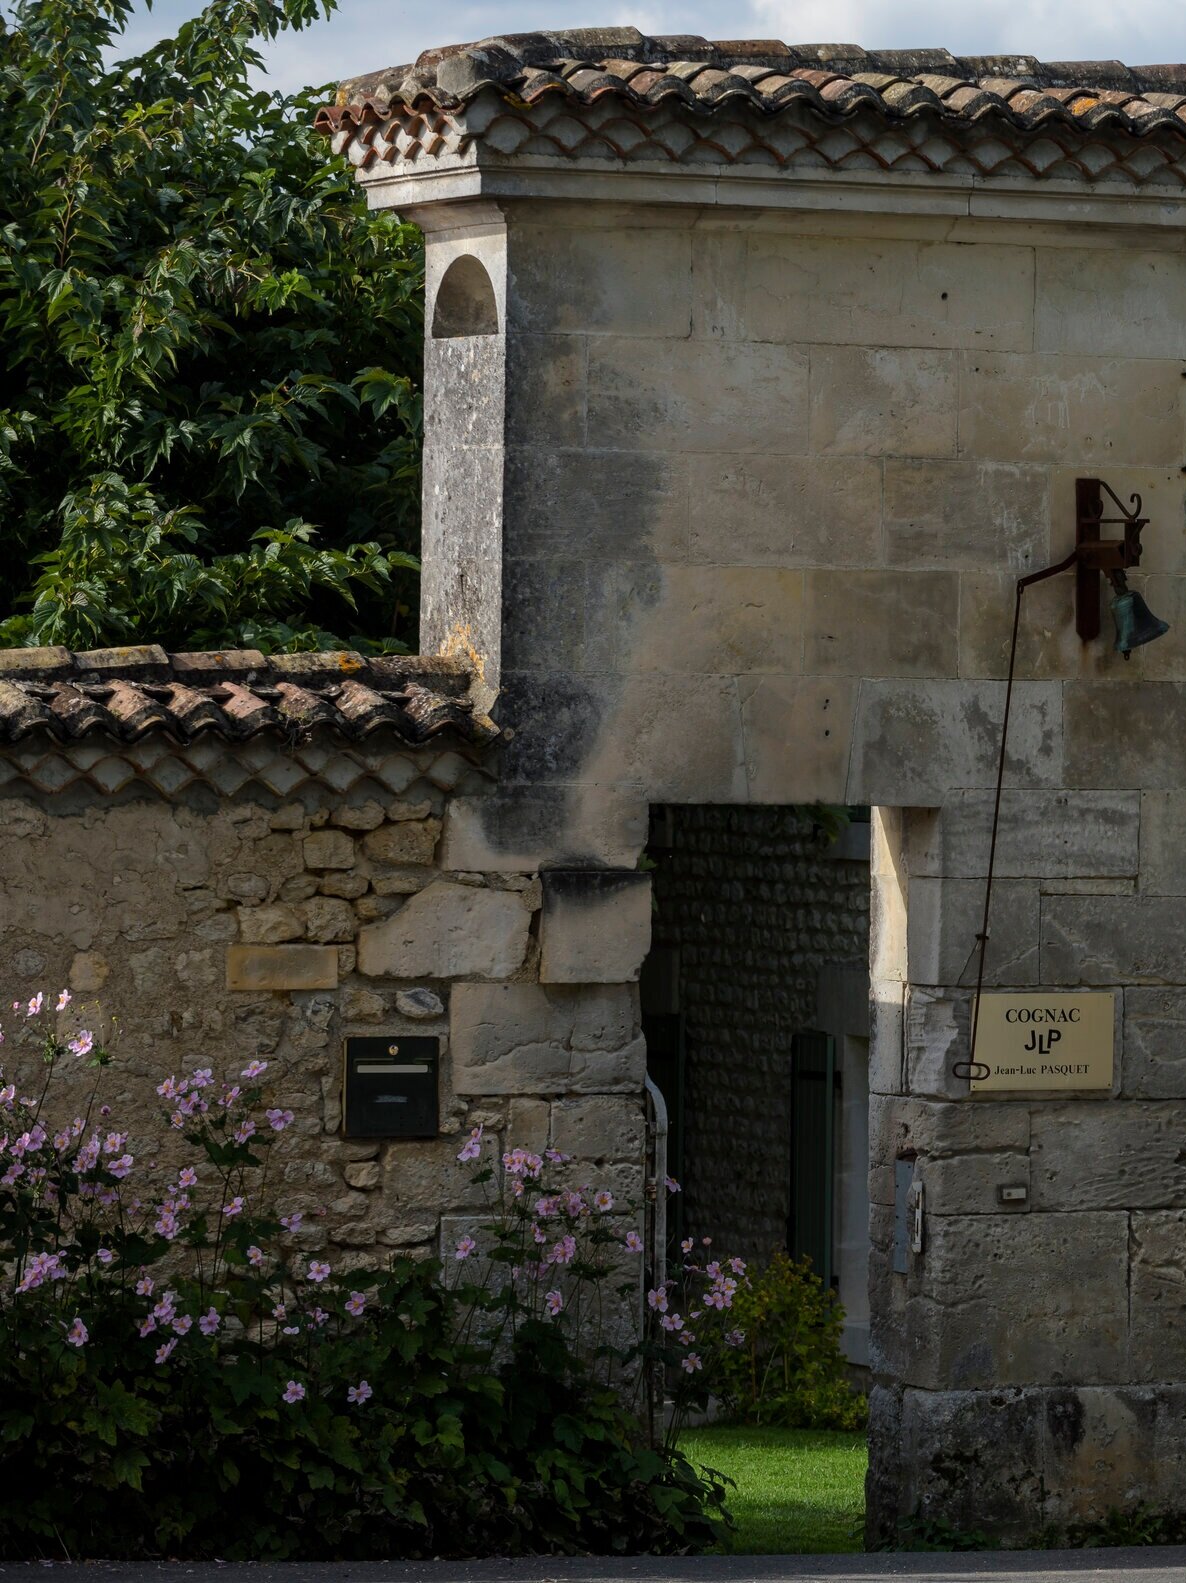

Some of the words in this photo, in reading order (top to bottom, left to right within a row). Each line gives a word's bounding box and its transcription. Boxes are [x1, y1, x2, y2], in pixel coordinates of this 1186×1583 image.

[1005, 1008, 1081, 1023] COGNAC
[1024, 1029, 1062, 1054] JLP
[994, 1065, 1037, 1075] Jean-Luc
[1041, 1064, 1090, 1076] PASQUET
